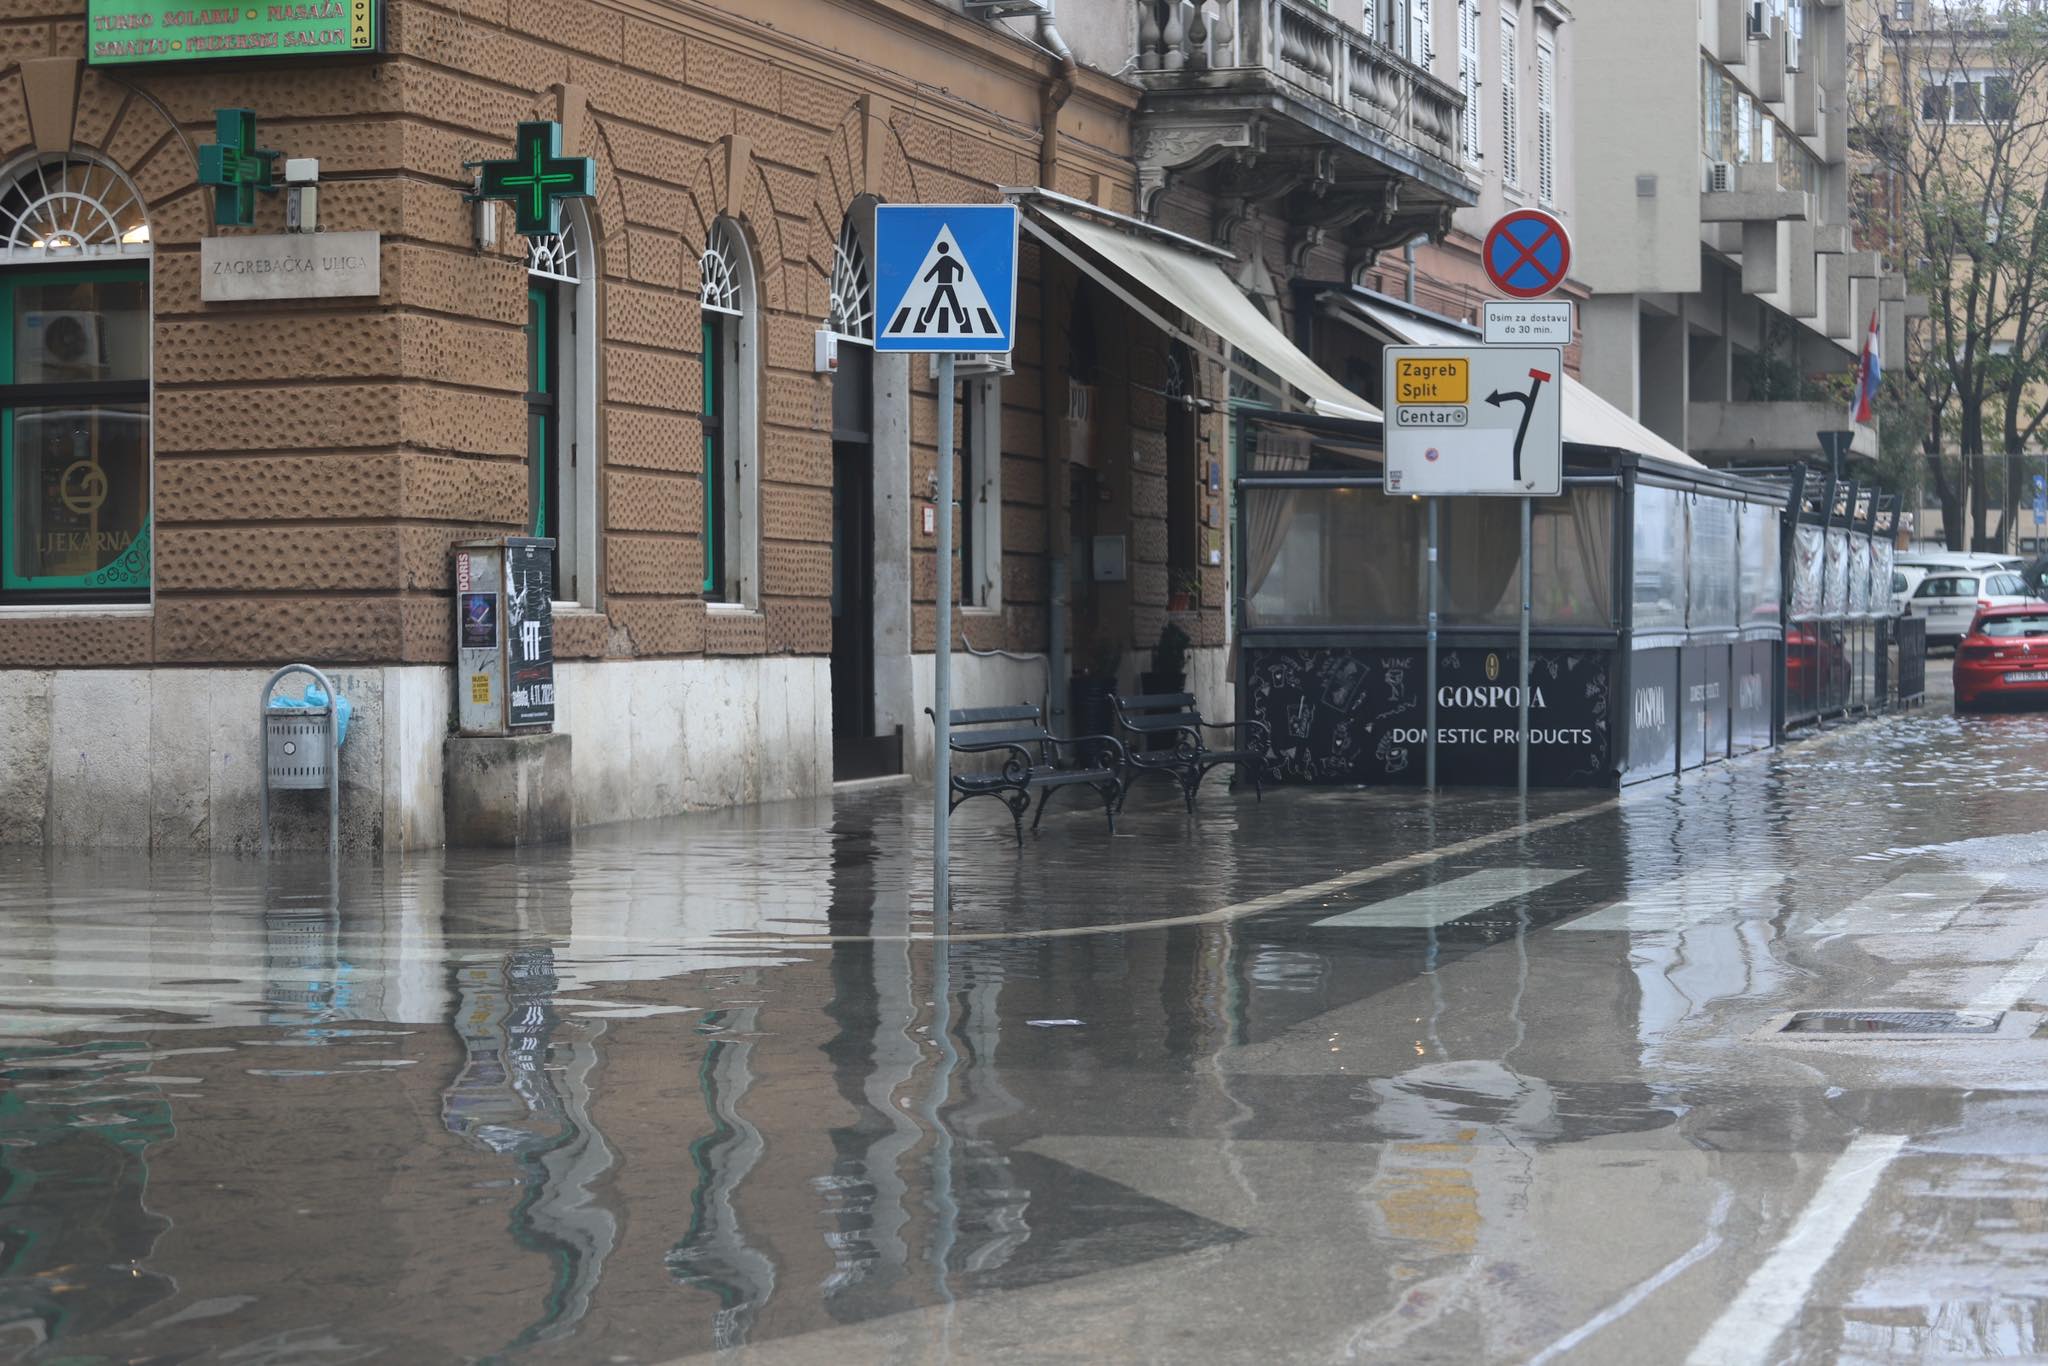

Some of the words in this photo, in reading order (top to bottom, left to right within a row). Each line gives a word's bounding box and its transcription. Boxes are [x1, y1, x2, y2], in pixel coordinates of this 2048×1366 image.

[94, 13, 153, 31] TURBO
[284, 29, 345, 47] SALON
[352, 37, 368, 45] 16
[213, 256, 315, 275] ZAGREBAČKA
[1490, 313, 1513, 322] Osim
[1530, 313, 1568, 322] dostavu
[1504, 325, 1515, 334] do
[1519, 325, 1530, 334] 30
[1533, 325, 1553, 334] min.
[1402, 363, 1457, 380] Zagreb
[1402, 383, 1437, 399] Split
[1400, 409, 1451, 423] Centar
[37, 531, 130, 553] LJEKARNA
[459, 553, 469, 591] DORIS
[1382, 657, 1413, 669] WINE
